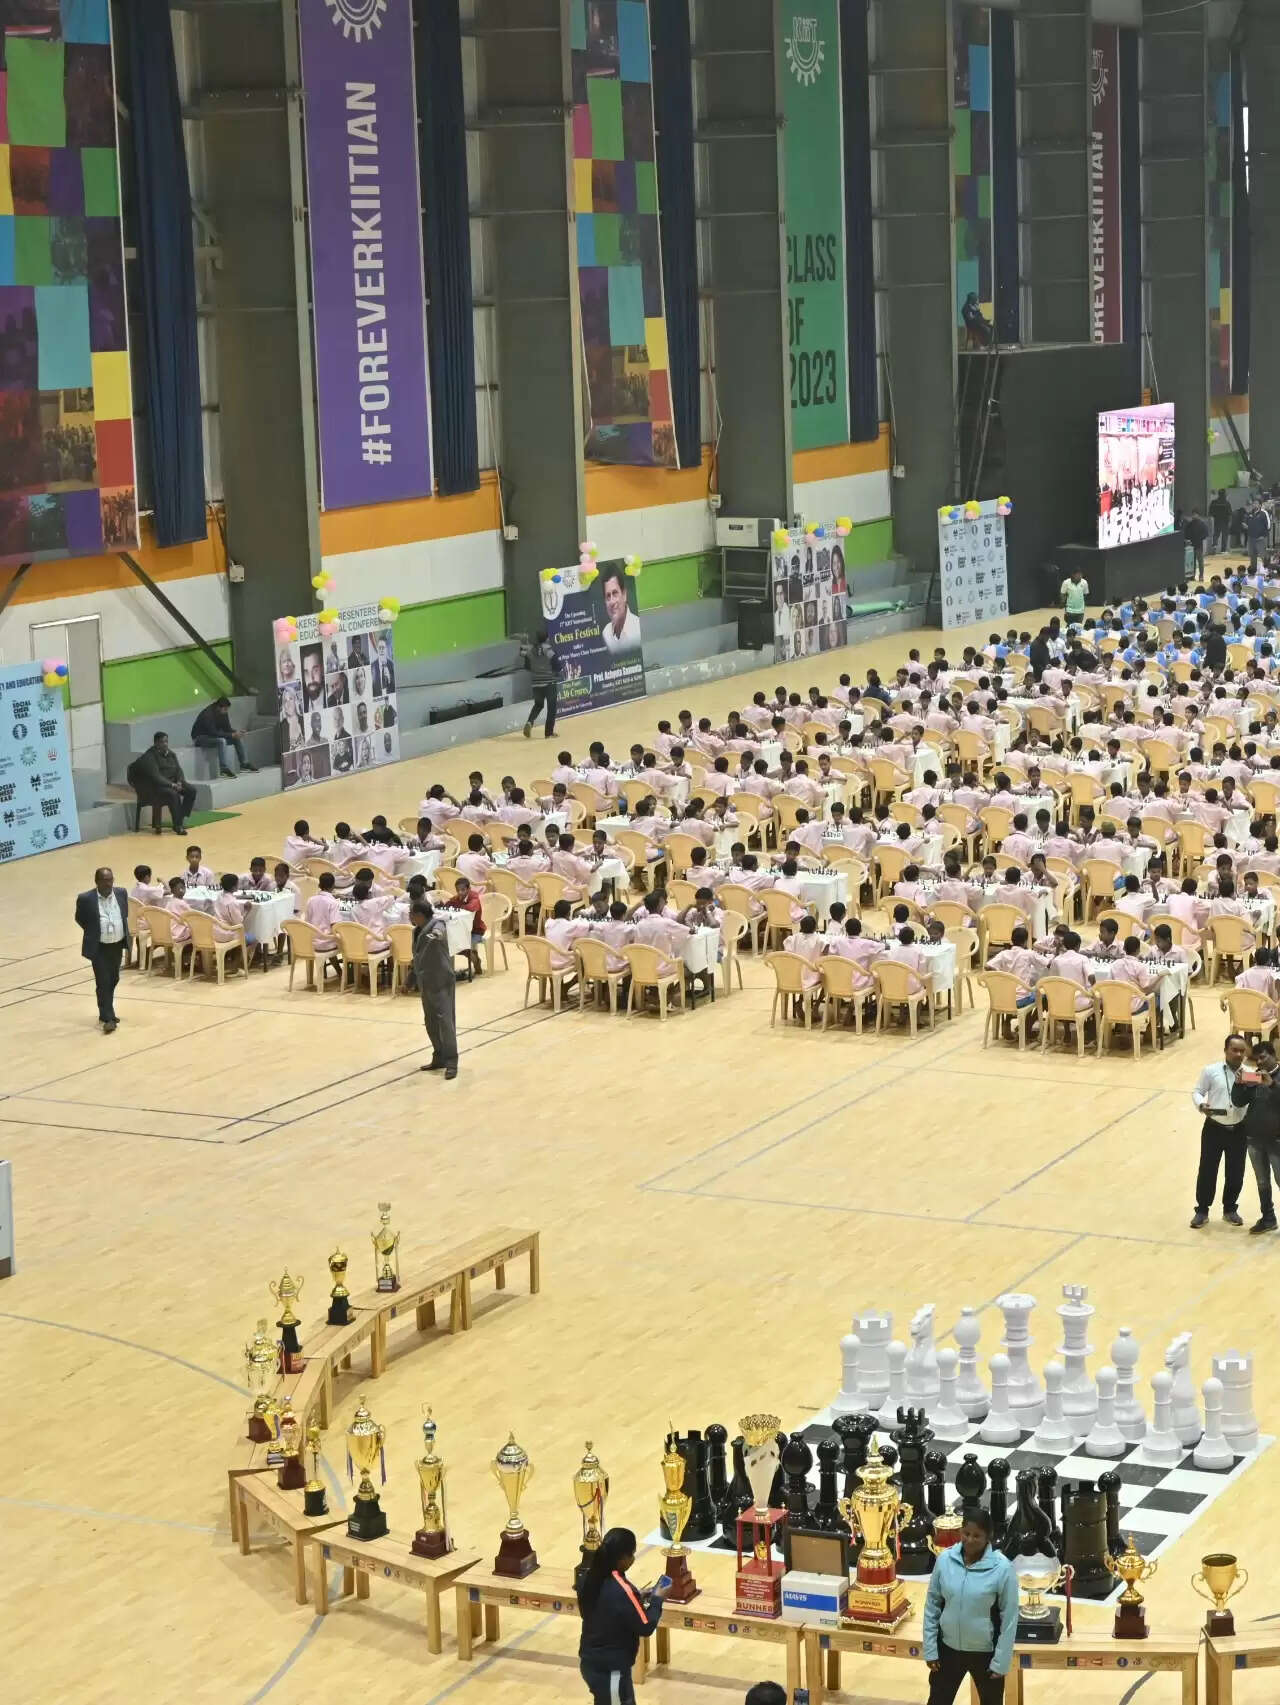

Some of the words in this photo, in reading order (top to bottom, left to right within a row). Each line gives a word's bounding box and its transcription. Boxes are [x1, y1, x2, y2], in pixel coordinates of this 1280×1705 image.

[345, 82, 392, 466] #FOREVERKIITIAN
[338, 606, 377, 620] RESENTERS
[554, 632, 574, 644] Chess
[575, 624, 600, 640] Festival
